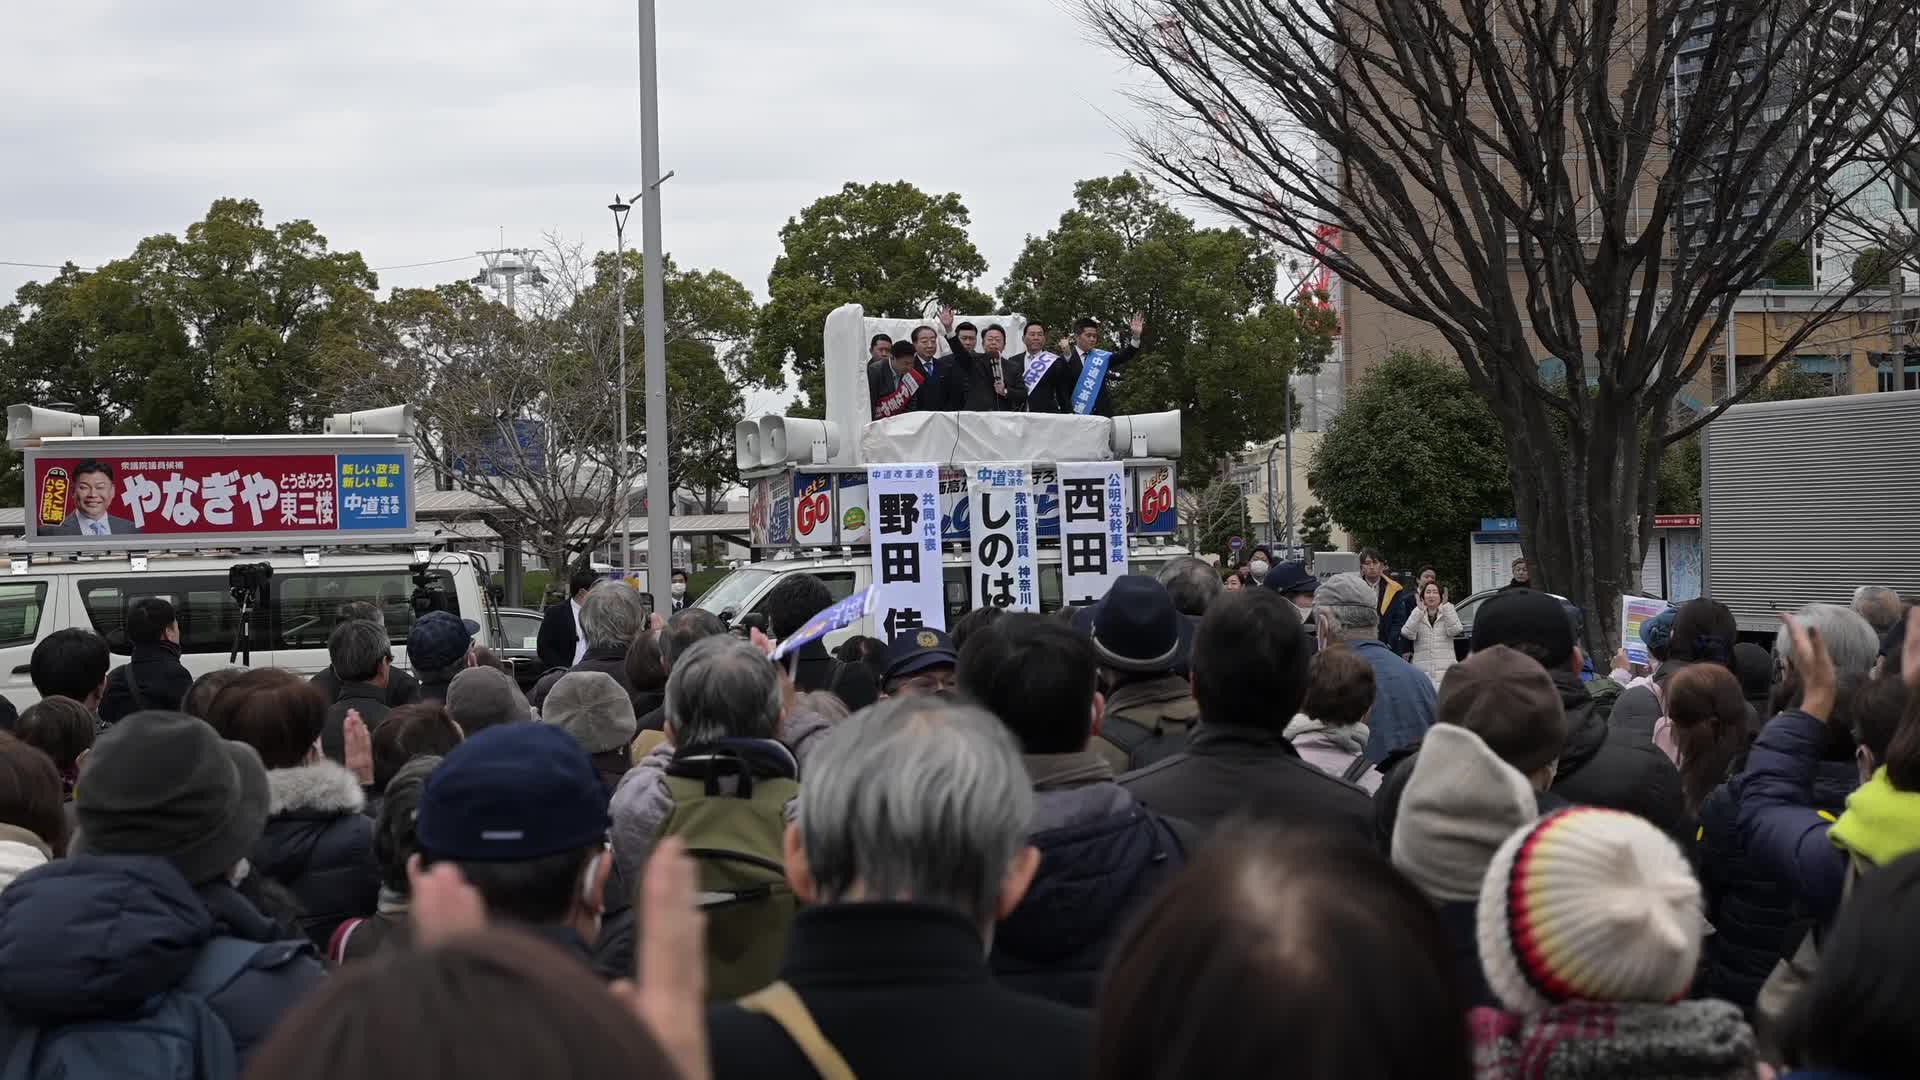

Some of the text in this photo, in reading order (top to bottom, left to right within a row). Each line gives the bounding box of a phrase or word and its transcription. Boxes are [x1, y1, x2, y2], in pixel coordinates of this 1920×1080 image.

[280, 472, 333, 489] とうざぶろう
[342, 464, 400, 475] 新しい政治
[872, 469, 935, 479] 中道改革連合
[977, 467, 1007, 487] 中道
[121, 470, 279, 529] やなぎや
[280, 491, 334, 525] 東三楼
[344, 493, 379, 515] 中道
[922, 492, 937, 552] 共同代表
[1015, 492, 1029, 558] 衆議院議員
[1108, 473, 1124, 563] 公明党幹事長
